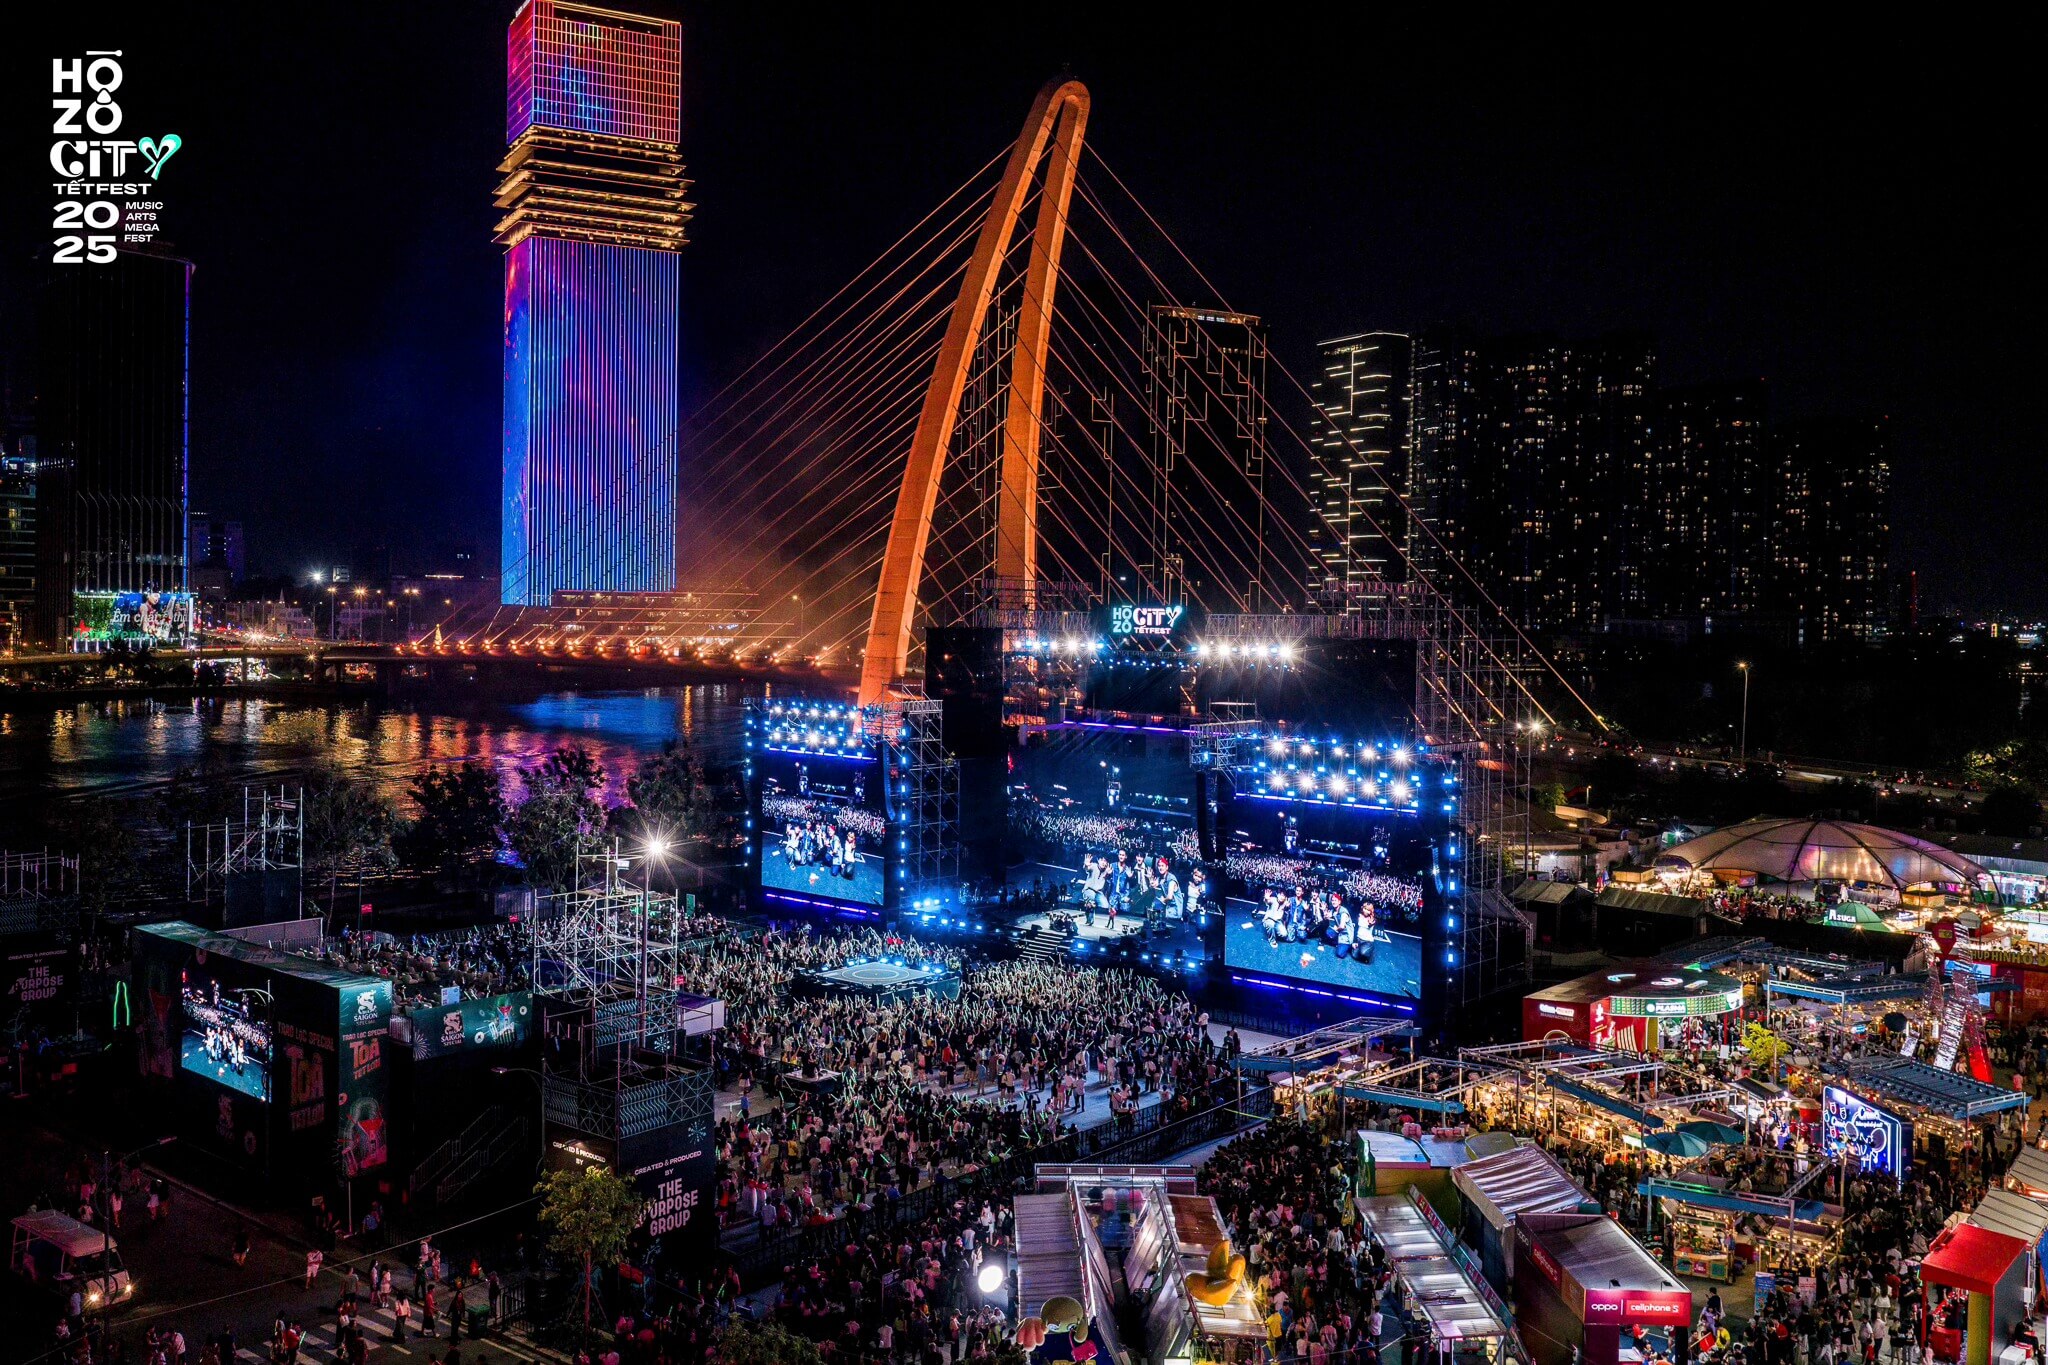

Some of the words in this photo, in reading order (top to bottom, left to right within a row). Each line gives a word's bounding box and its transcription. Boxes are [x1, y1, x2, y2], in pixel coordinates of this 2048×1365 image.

[28, 965, 49, 978] THE
[21, 987, 57, 1002] GROUP
[353, 1012, 378, 1022] SAIGON
[440, 1032, 465, 1042] SAIGON
[580, 1149, 606, 1163] PRODUCED
[634, 1162, 663, 1176] CREATED
[669, 1150, 702, 1165] PRODUCED
[665, 1168, 674, 1177] BY
[658, 1178, 683, 1200] THE
[650, 1209, 691, 1237] GROUP
